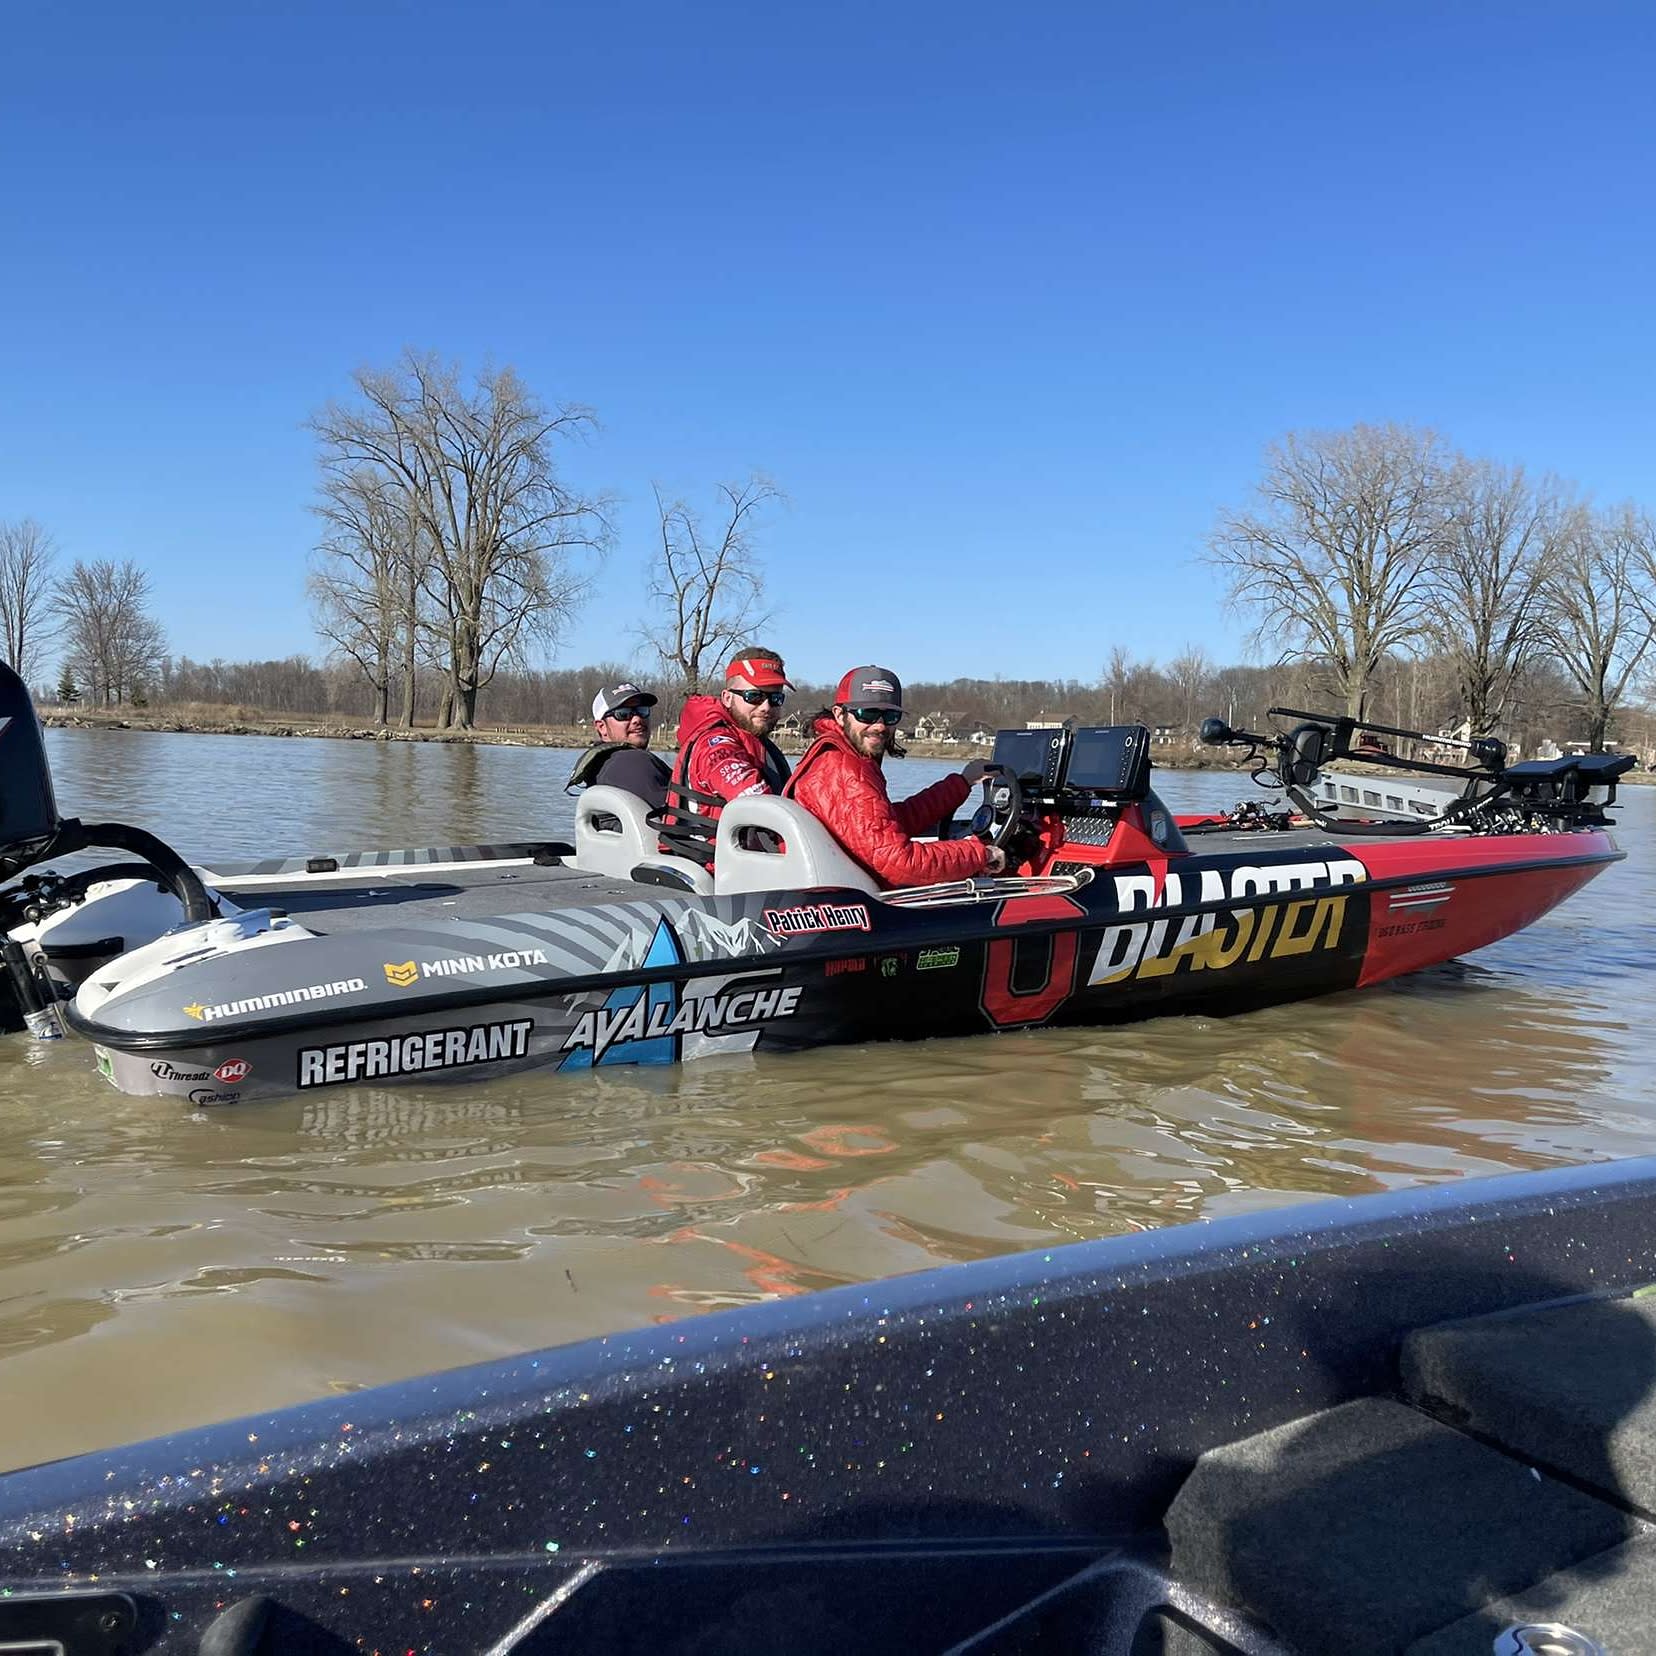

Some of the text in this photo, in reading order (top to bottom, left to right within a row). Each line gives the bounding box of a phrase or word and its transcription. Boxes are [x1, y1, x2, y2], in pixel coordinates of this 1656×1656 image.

[767, 906, 868, 932] Patrick Henry
[421, 949, 548, 978] MINN KOTA
[203, 978, 366, 1022] HUMMINBIRD
[562, 986, 803, 1062] AVALANCHE
[222, 1063, 247, 1079] DQ
[299, 1021, 532, 1087] REFRIGERANT
